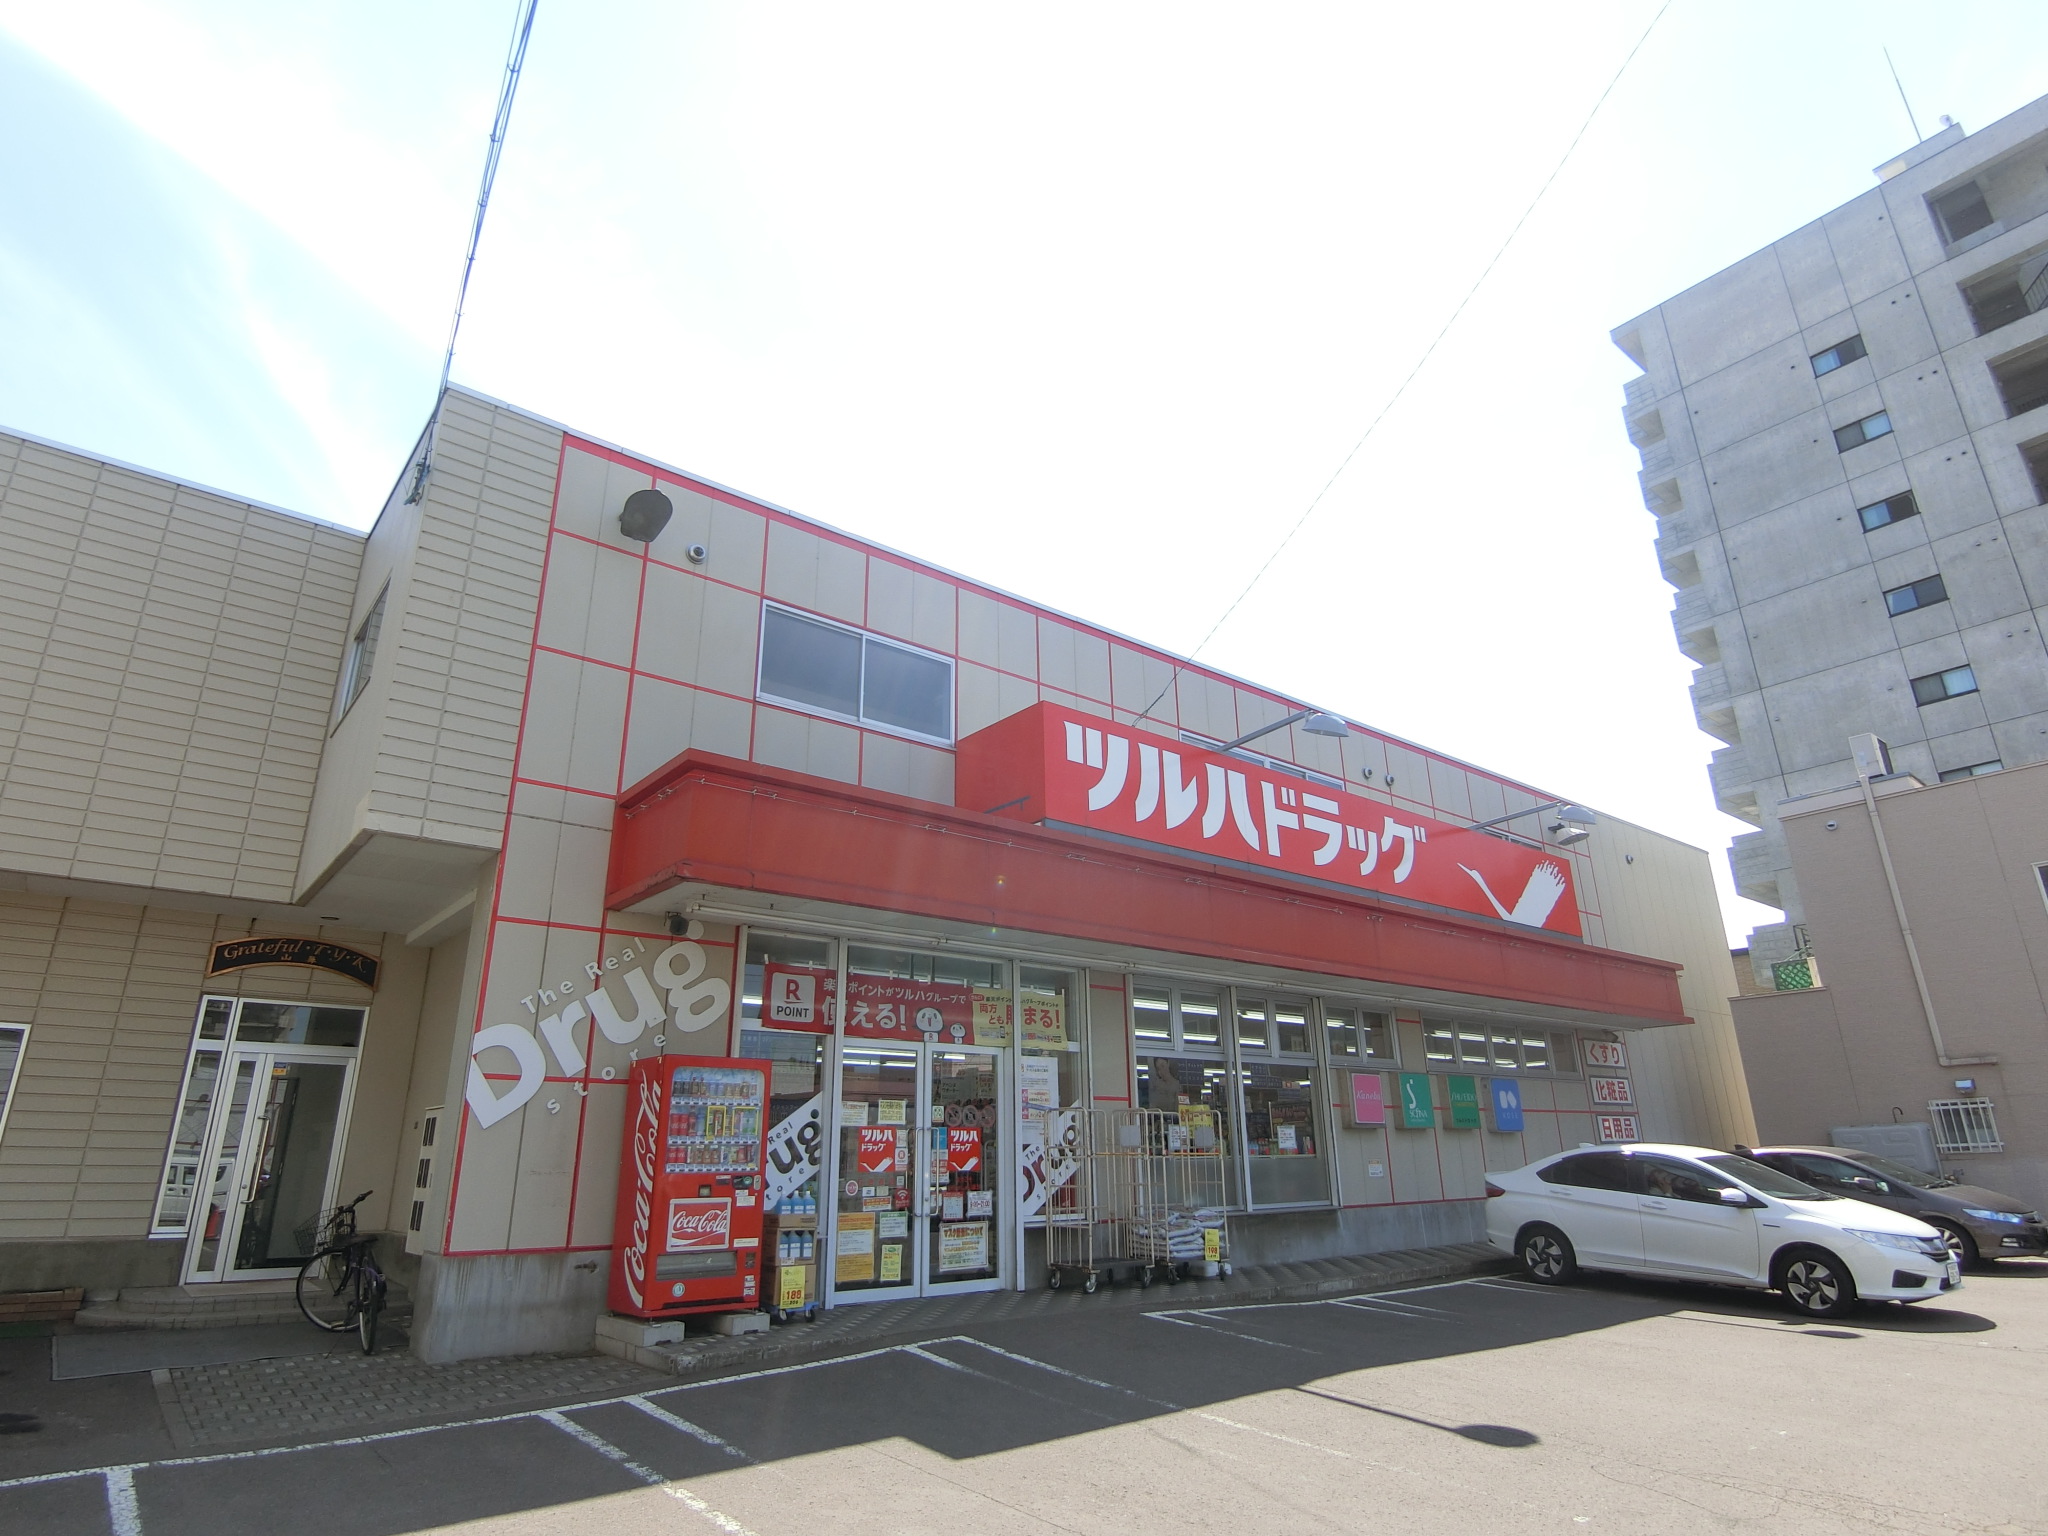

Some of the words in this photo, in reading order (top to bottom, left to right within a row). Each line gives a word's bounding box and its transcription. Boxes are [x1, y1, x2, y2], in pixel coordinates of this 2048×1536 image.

[1063, 720, 1427, 884] ツルハドラッグ
[521, 980, 574, 1014] The
[584, 936, 646, 981] Real
[776, 1005, 810, 1018] POINT
[466, 919, 731, 1130] Drug
[1590, 1043, 1620, 1064] くすり
[546, 1034, 667, 1114] store
[1595, 1080, 1629, 1101] 化粧品
[768, 1121, 793, 1145] Real
[861, 1129, 894, 1142] ツルハ
[950, 1130, 979, 1142] ツルハ
[1602, 1117, 1635, 1139] 日用品
[861, 1143, 887, 1152] ドラッグ
[950, 1143, 973, 1152] ドラッグ
[1025, 1145, 1040, 1160] The
[786, 1289, 802, 1300] 188
